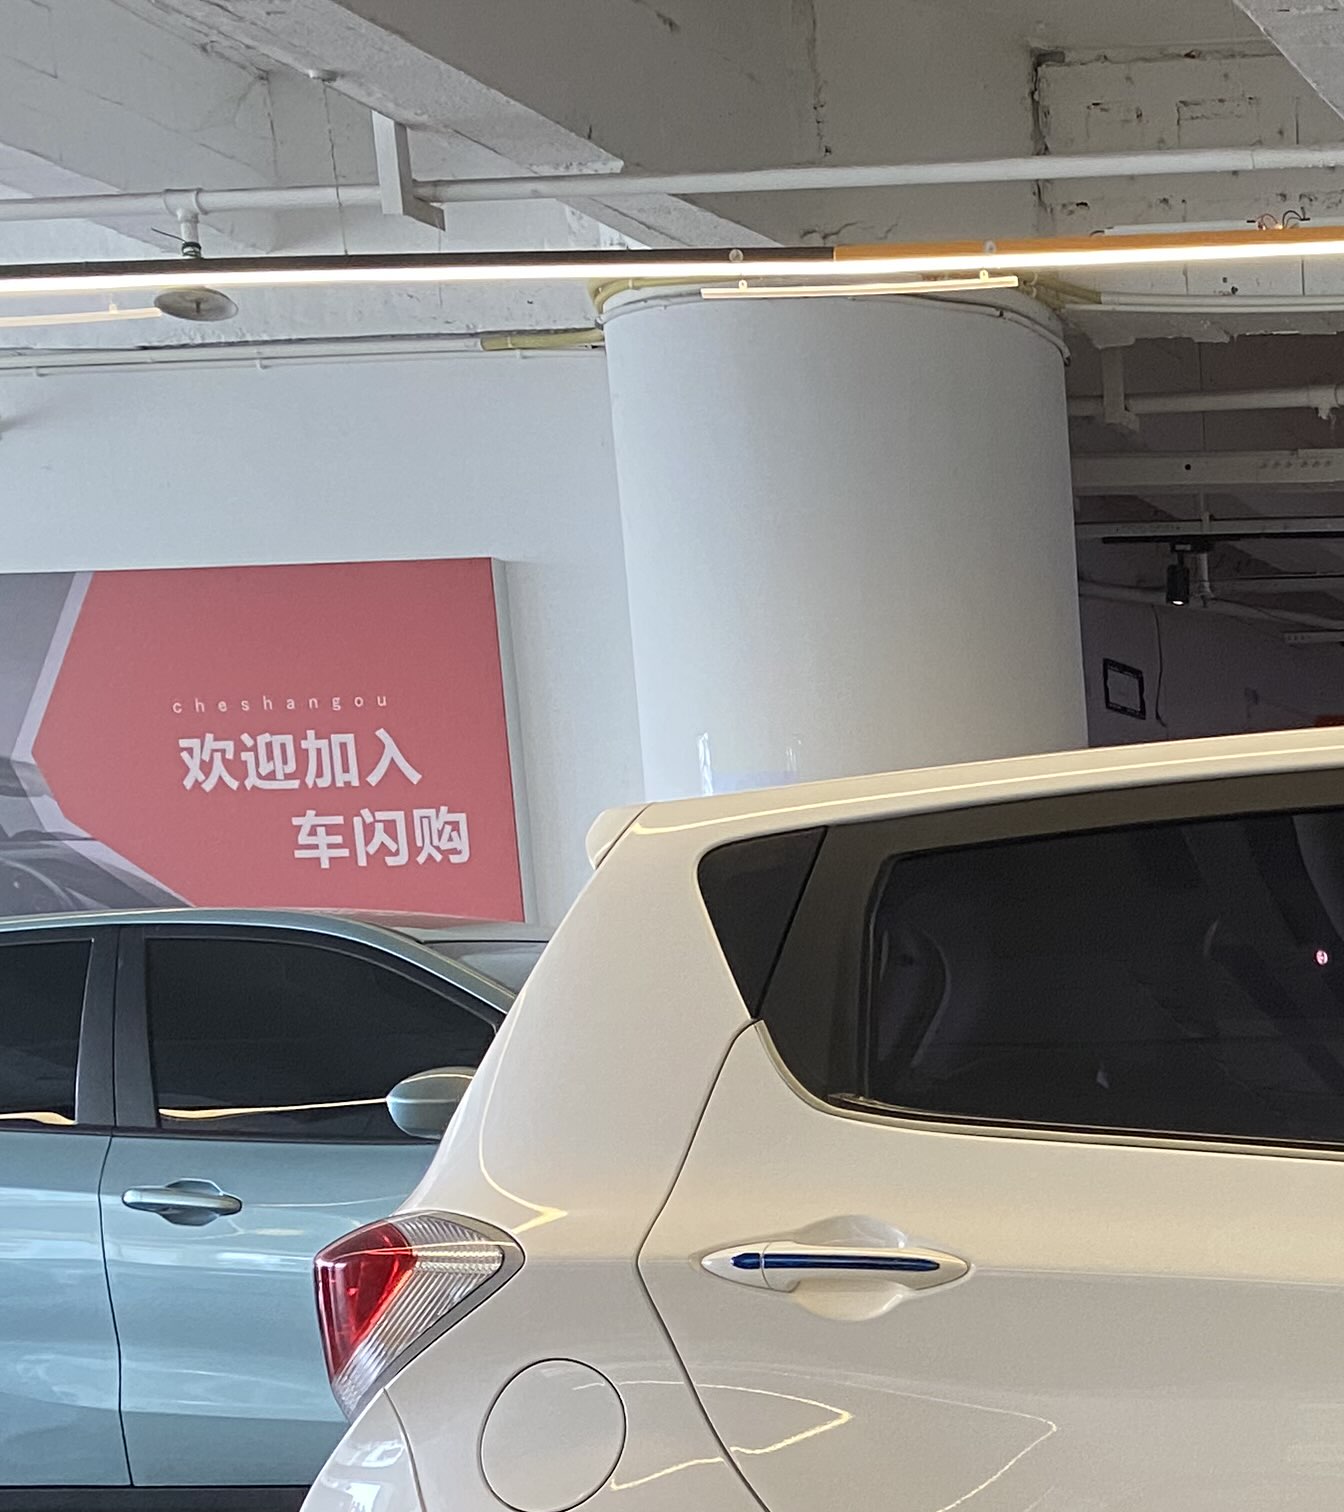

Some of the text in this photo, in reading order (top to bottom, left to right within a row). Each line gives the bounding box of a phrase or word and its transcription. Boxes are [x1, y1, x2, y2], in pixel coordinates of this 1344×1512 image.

[172, 695, 387, 714] cheshangou
[178, 727, 423, 793] 欢迎加入
[291, 805, 471, 869] 车闪购
